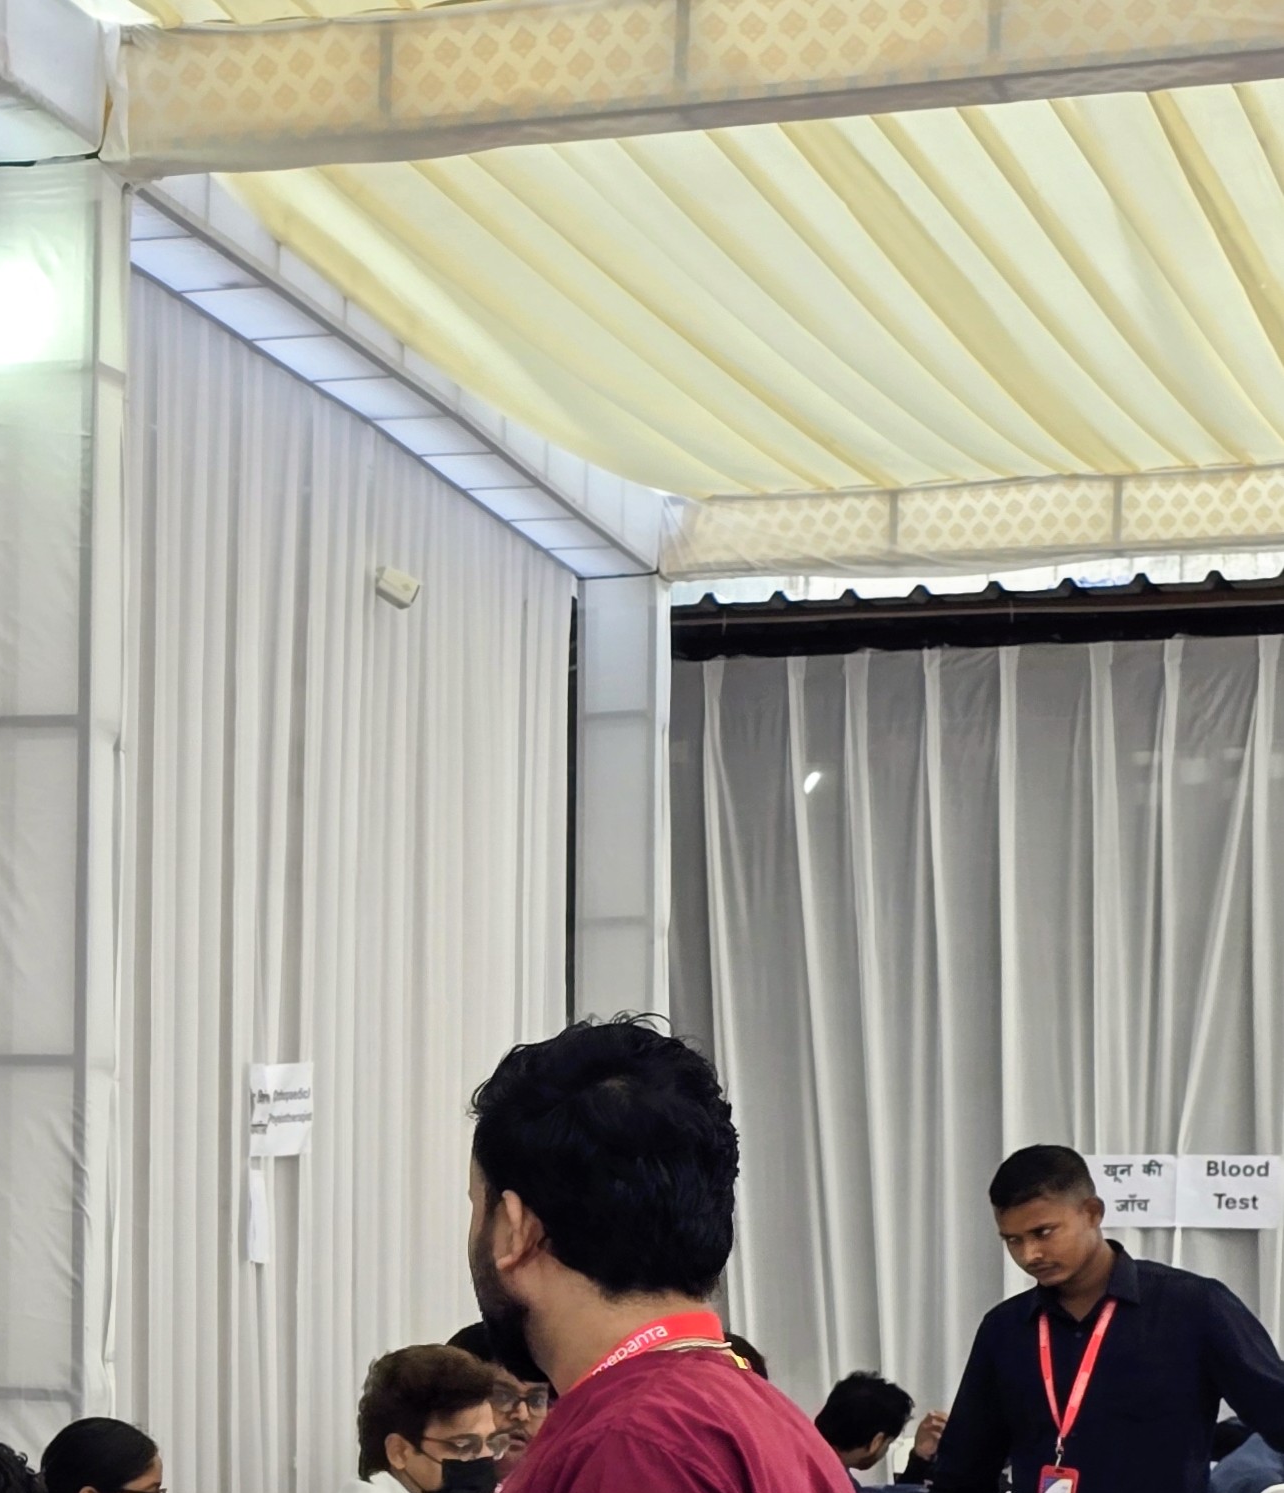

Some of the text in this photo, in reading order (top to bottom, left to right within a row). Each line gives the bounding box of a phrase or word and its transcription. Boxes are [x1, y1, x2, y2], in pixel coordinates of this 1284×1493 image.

[1103, 1159, 1164, 1183] खून की
[1206, 1160, 1270, 1177] Blood
[1213, 1193, 1259, 1210] Test
